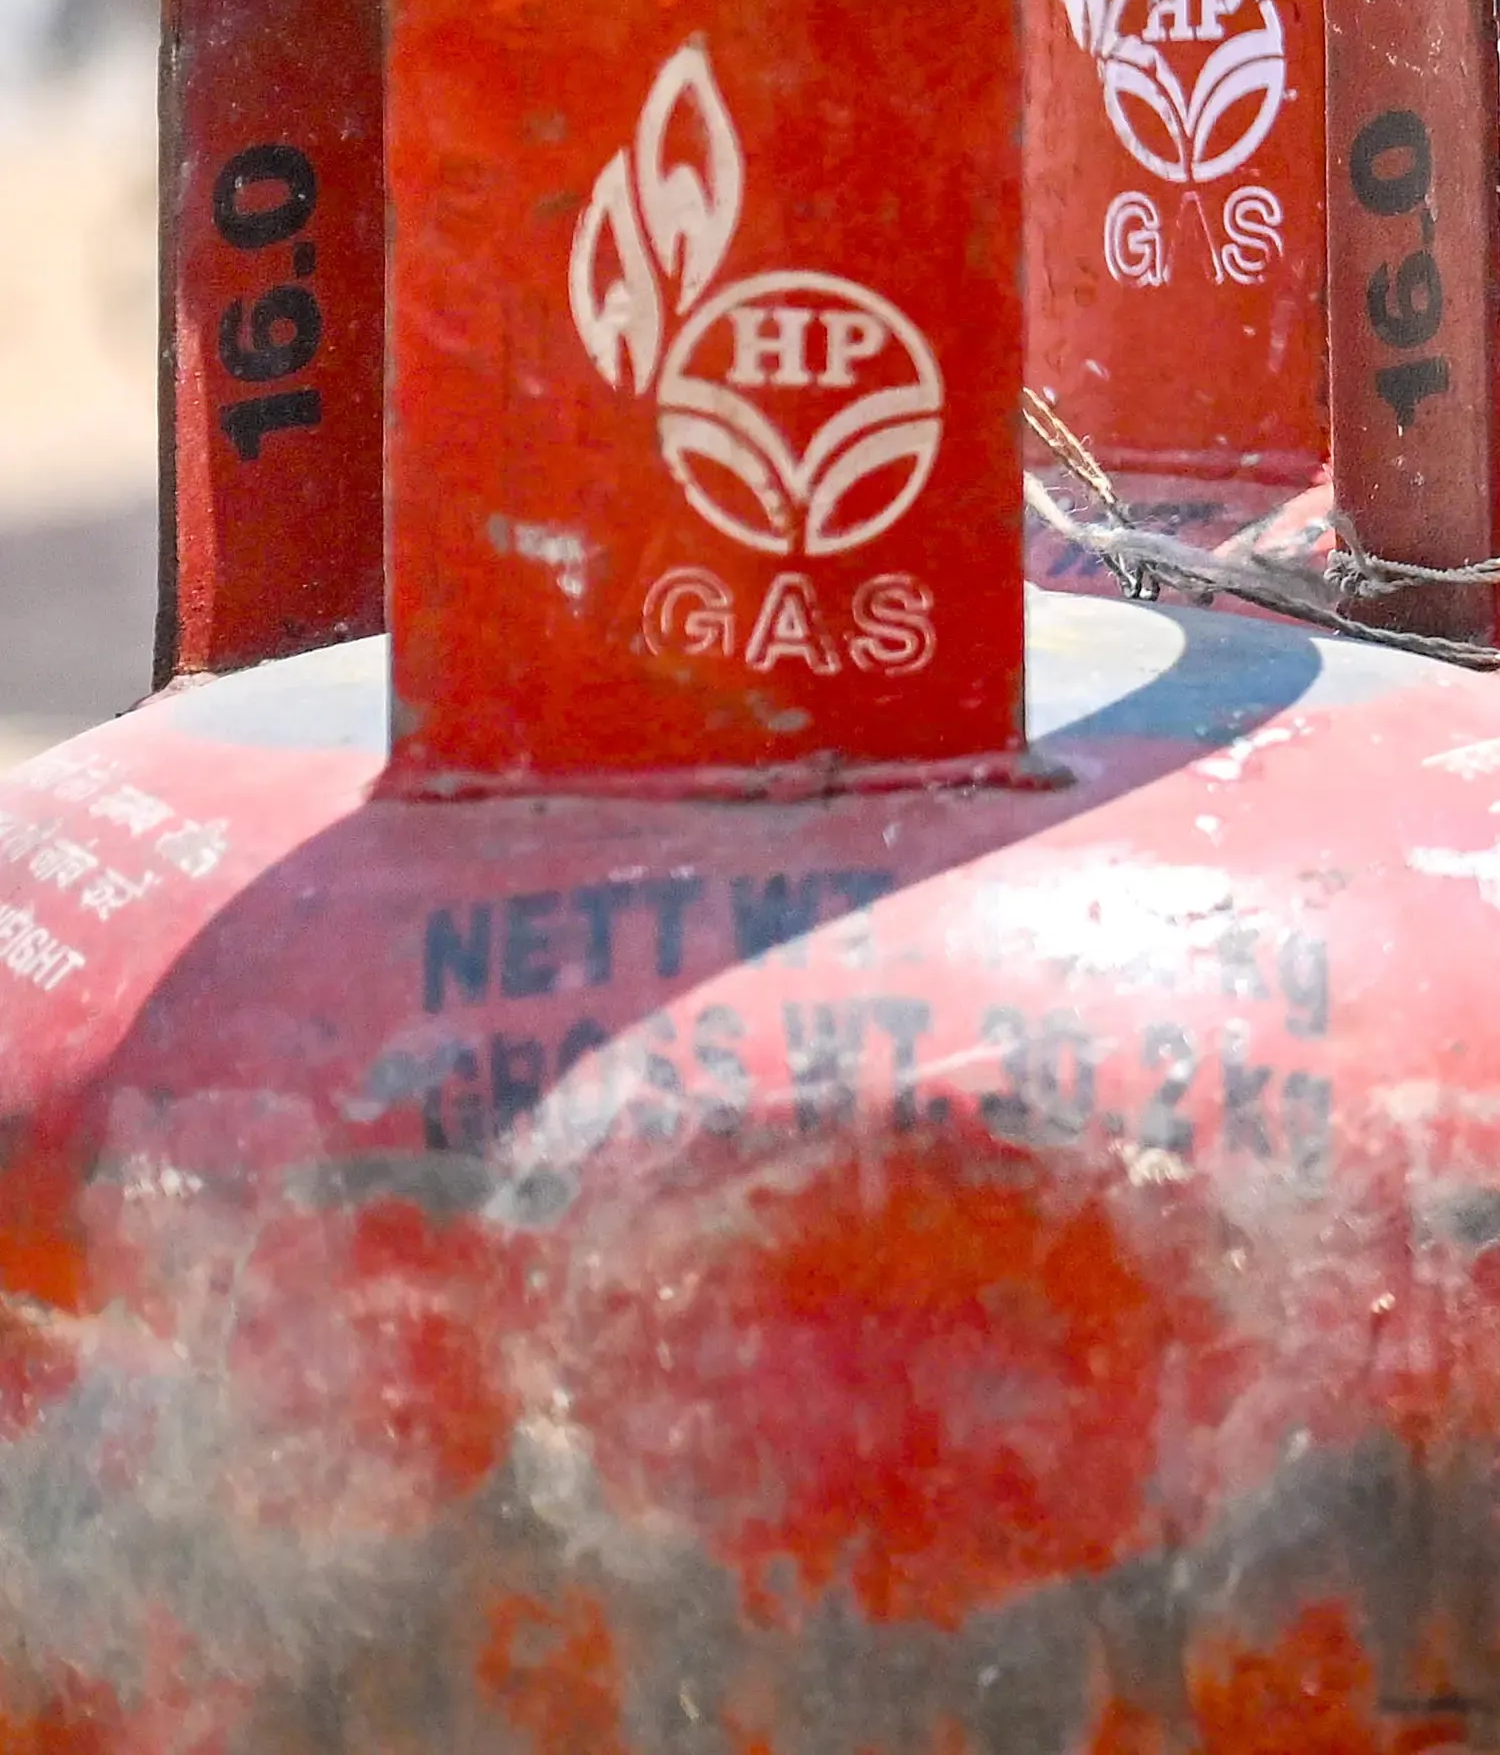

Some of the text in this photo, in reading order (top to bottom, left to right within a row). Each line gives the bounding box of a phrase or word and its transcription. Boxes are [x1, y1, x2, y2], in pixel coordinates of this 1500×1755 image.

[212, 142, 323, 464] 16.0
[1103, 185, 1284, 287] GAS
[1347, 107, 1453, 431] 16.0
[725, 303, 887, 391] HP
[641, 567, 937, 677] GAS
[422, 874, 706, 1014] NETT
[420, 1005, 754, 1158] GROSS
